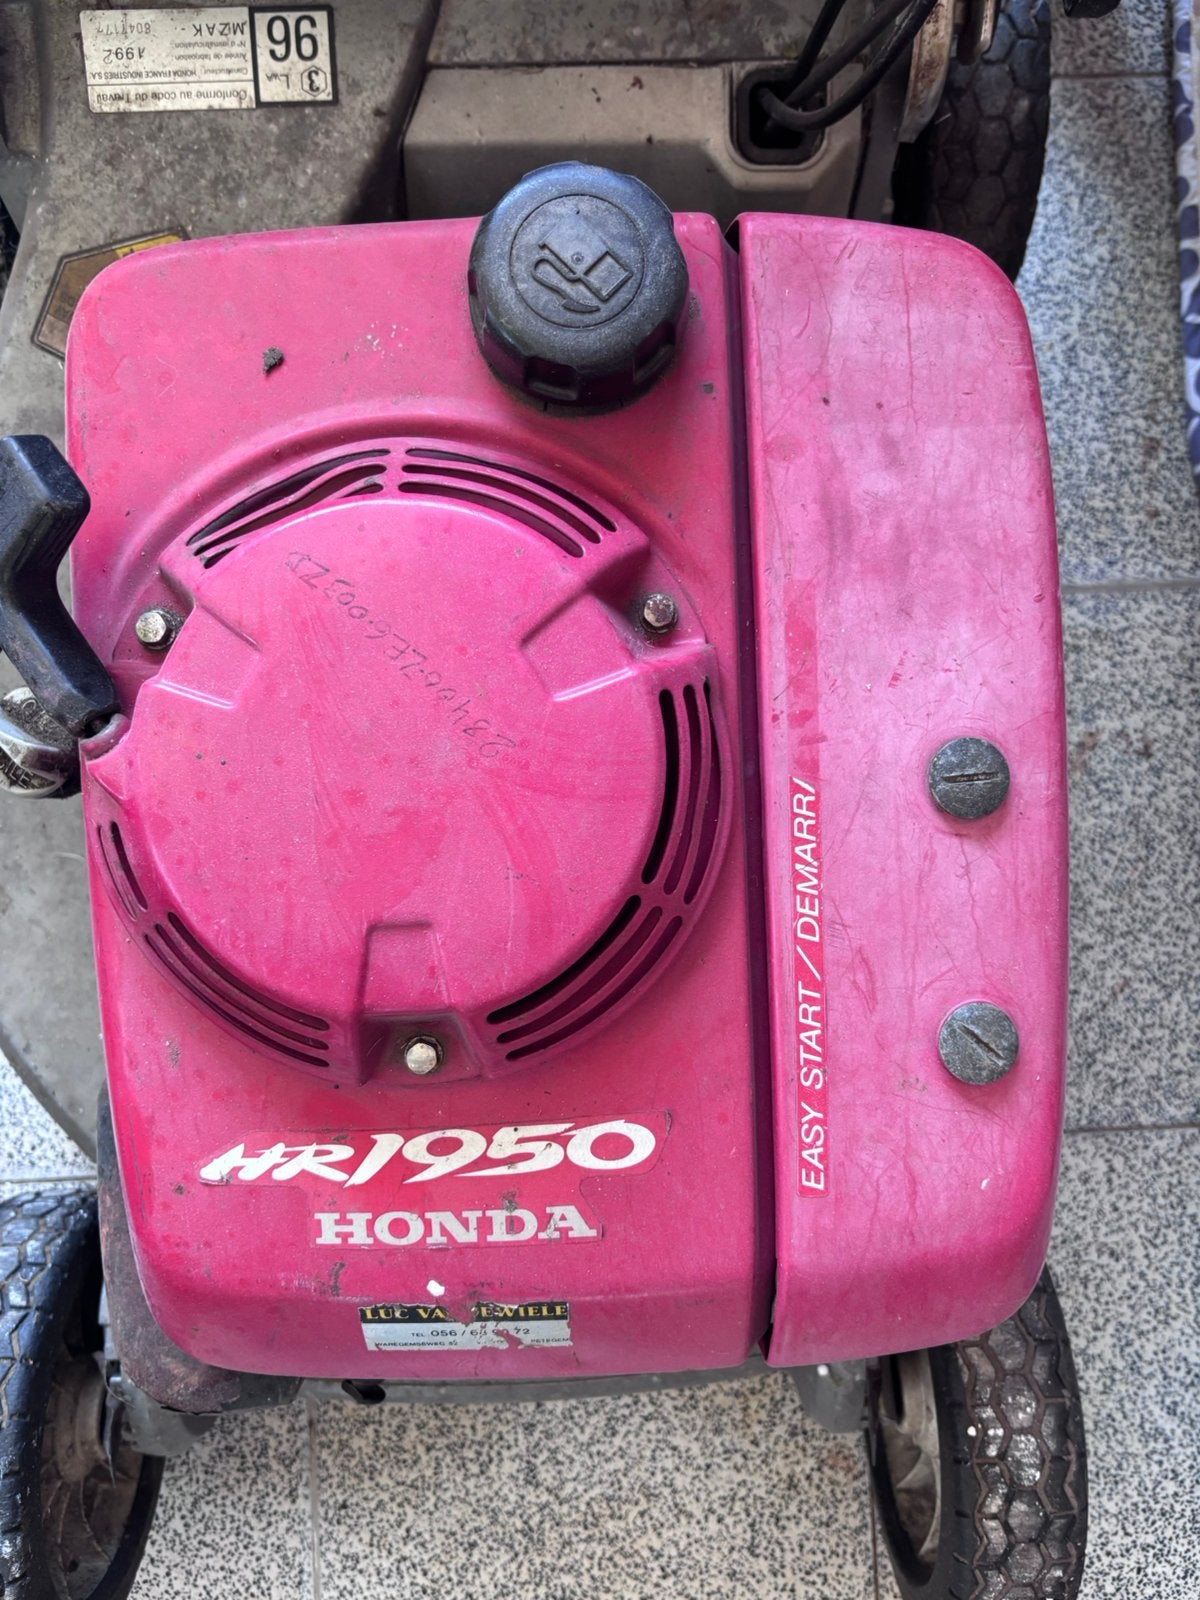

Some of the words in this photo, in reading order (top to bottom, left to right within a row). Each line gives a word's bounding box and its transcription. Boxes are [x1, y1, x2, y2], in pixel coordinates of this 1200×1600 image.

[266, 14, 319, 62] 96
[103, 47, 145, 64] 1992
[306, 70, 320, 92] 3
[135, 93, 149, 101] du
[151, 92, 177, 101] code
[180, 90, 193, 99] au
[196, 90, 247, 100] Conforme
[798, 981, 823, 1089] START
[199, 1119, 657, 1188] HR1950
[800, 1101, 824, 1191] EASY
[313, 1204, 598, 1246] HONDA
[365, 1307, 410, 1320] LUC
[430, 1329, 458, 1337] 056
